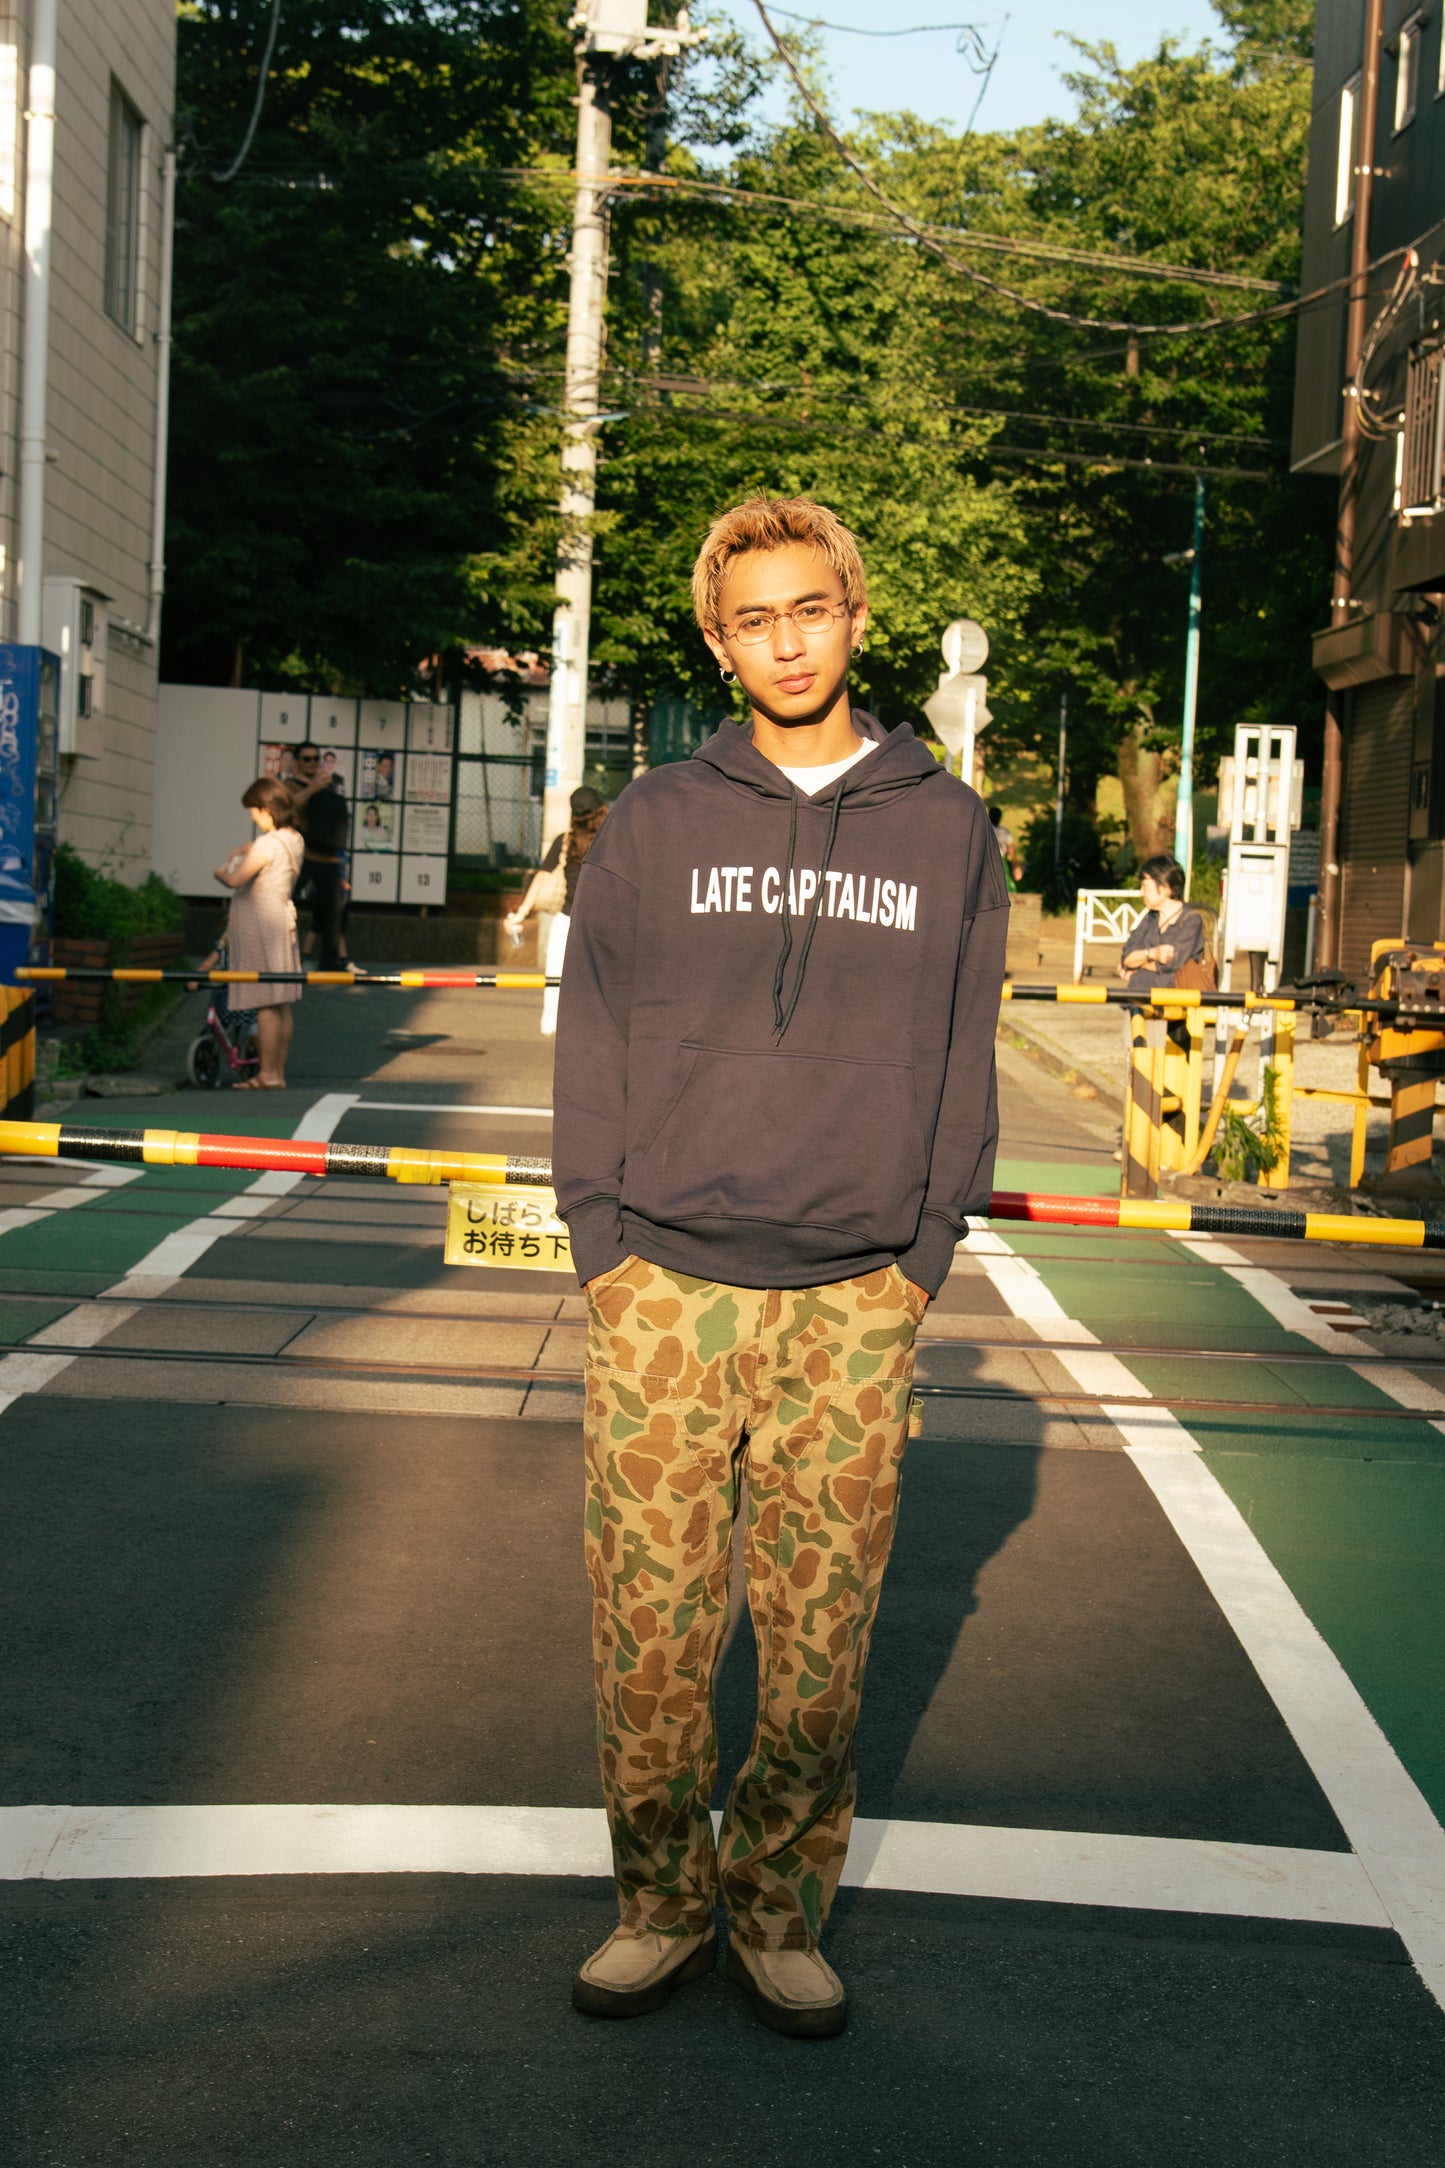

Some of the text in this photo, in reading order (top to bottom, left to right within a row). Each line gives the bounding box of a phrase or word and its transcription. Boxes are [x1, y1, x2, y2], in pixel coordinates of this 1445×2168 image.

[368, 872, 382, 884] 10
[690, 866, 754, 914] LATE
[463, 1229, 571, 1260] お待ち下
